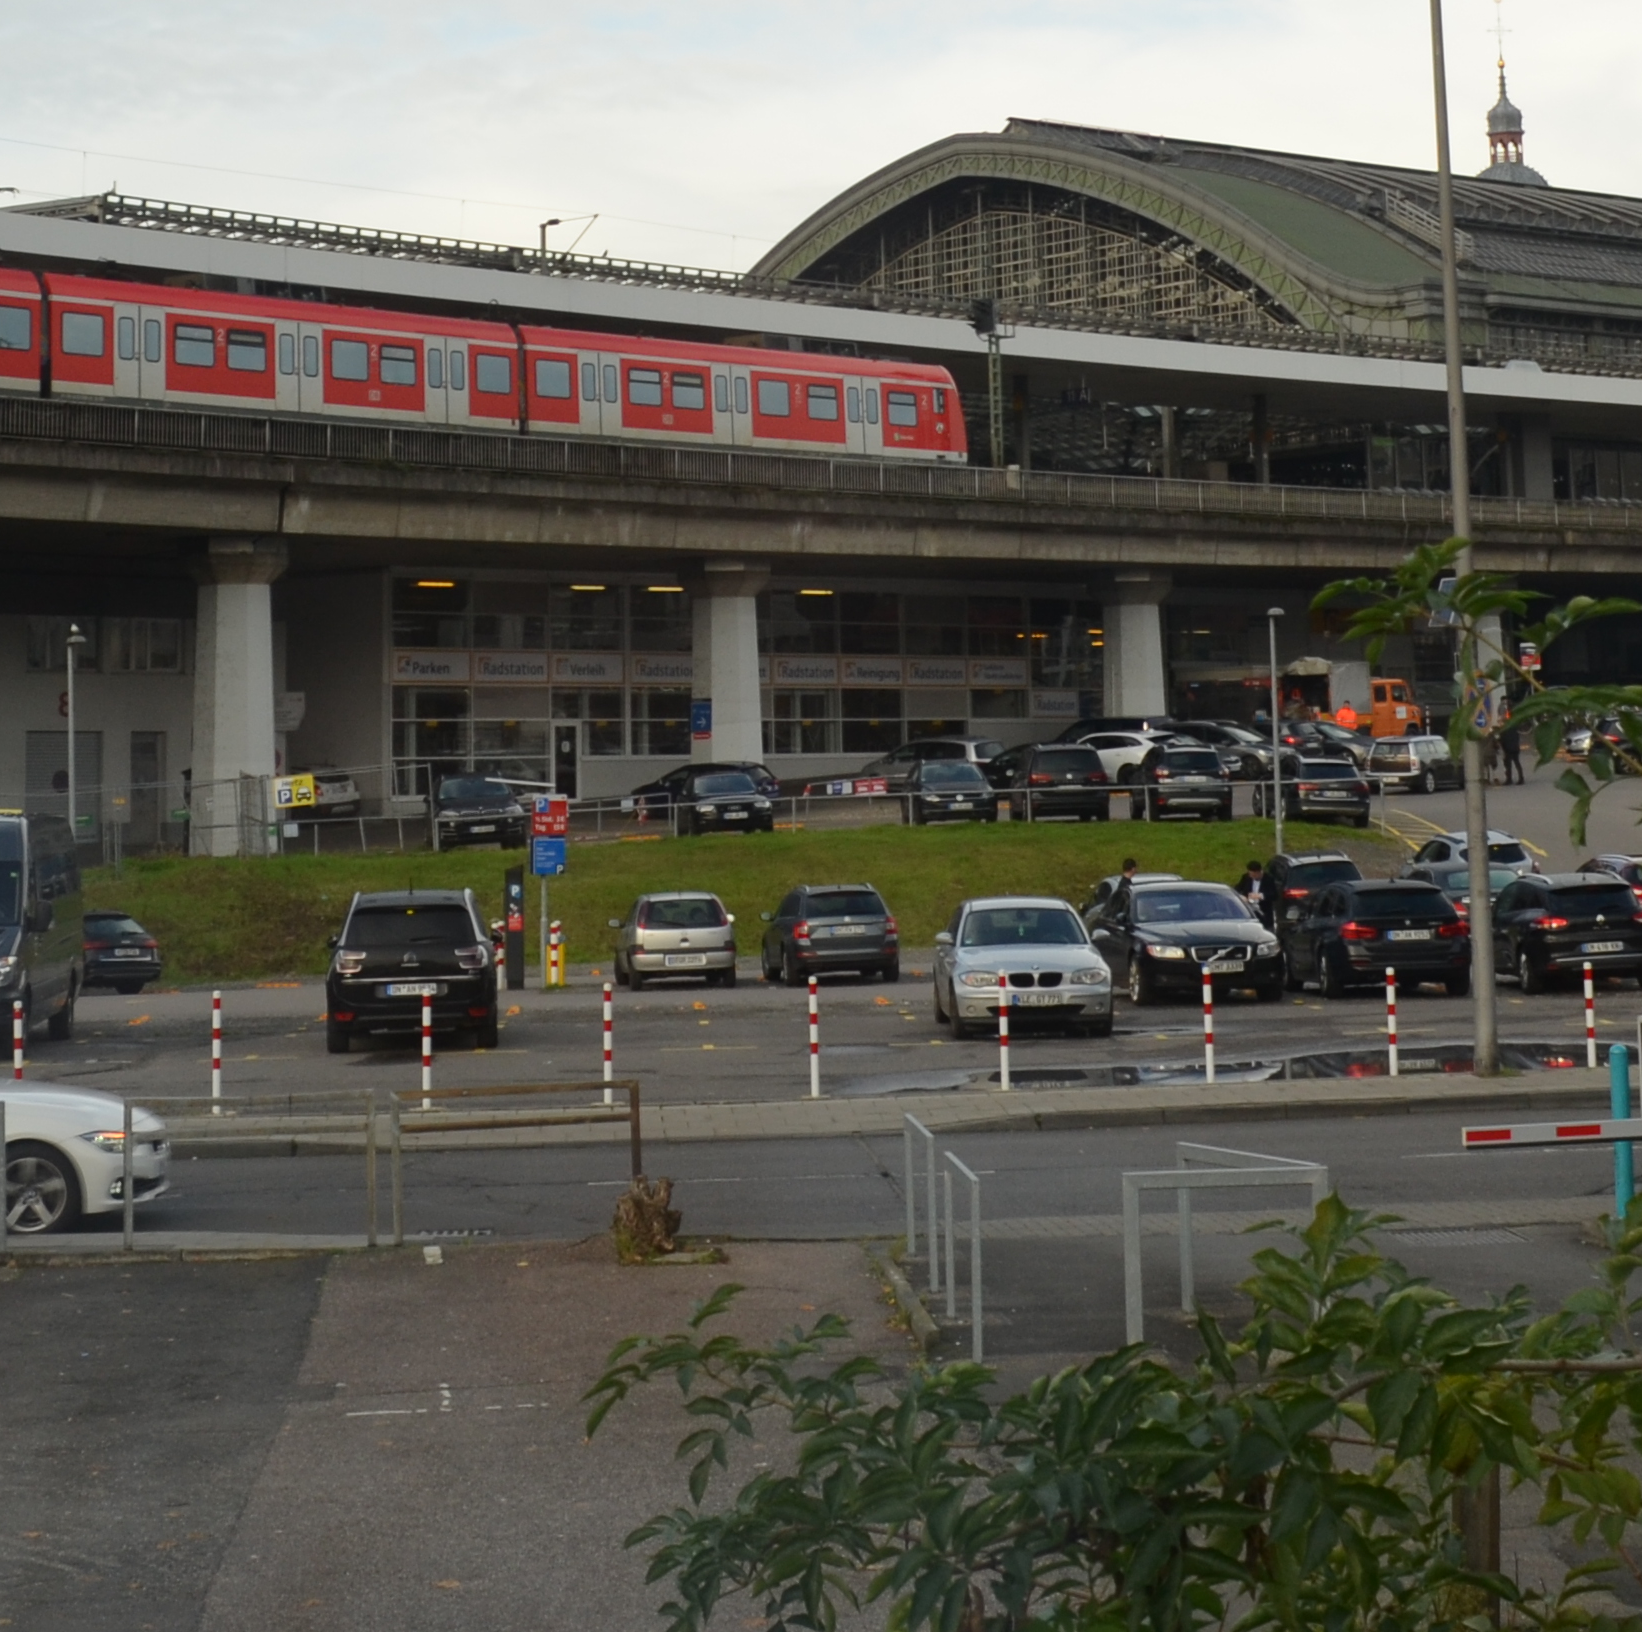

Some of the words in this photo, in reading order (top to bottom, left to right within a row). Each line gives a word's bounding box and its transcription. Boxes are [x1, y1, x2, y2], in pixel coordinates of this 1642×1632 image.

[216, 328, 226, 341] 2
[369, 344, 378, 357] 2
[662, 371, 670, 383] 2
[411, 661, 450, 675] Parken
[483, 661, 544, 676] Radstation
[569, 662, 605, 676] Verleih
[781, 664, 834, 678] Radstation
[856, 665, 900, 682] Reinigung
[913, 667, 963, 680] Radstation
[280, 790, 291, 804] P
[536, 798, 545, 813] P
[556, 864, 564, 875] P
[511, 884, 519, 895] P
